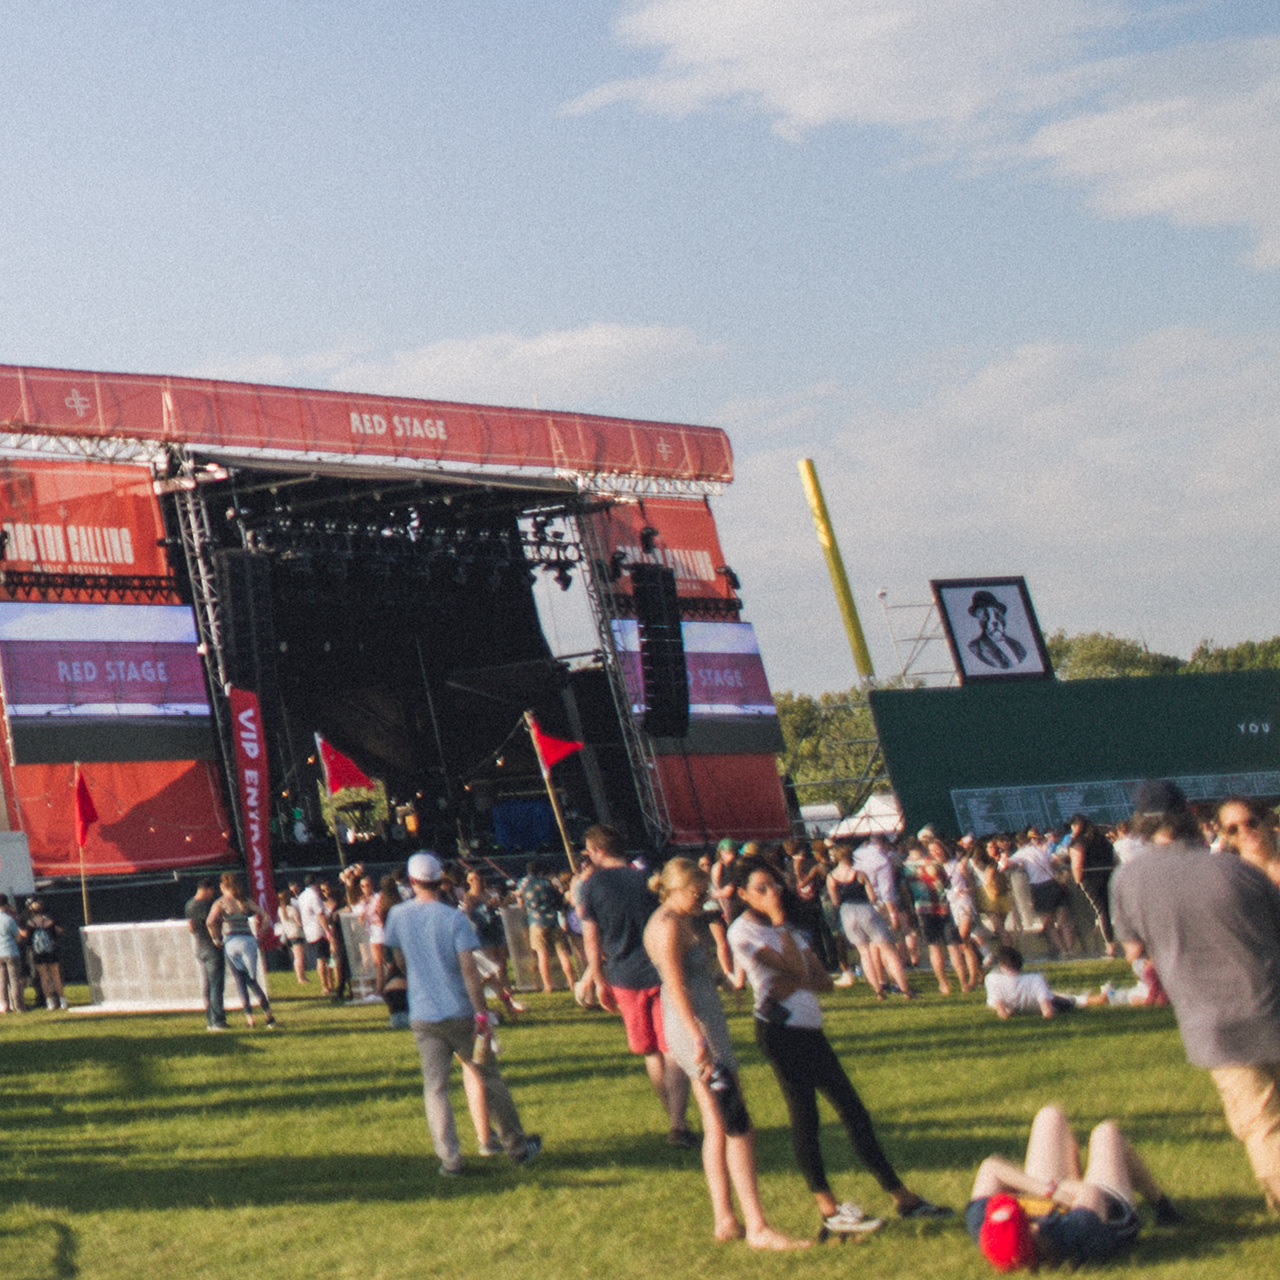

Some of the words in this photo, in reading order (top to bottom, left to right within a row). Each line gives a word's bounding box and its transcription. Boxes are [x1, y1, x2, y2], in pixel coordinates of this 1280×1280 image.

[350, 412, 387, 435] RED
[392, 415, 447, 440] STAGE
[67, 525, 134, 564] CALLING
[58, 660, 98, 681] RED
[105, 660, 168, 682] STAGE
[238, 709, 260, 759] VIP
[1237, 722, 1270, 734] YOU
